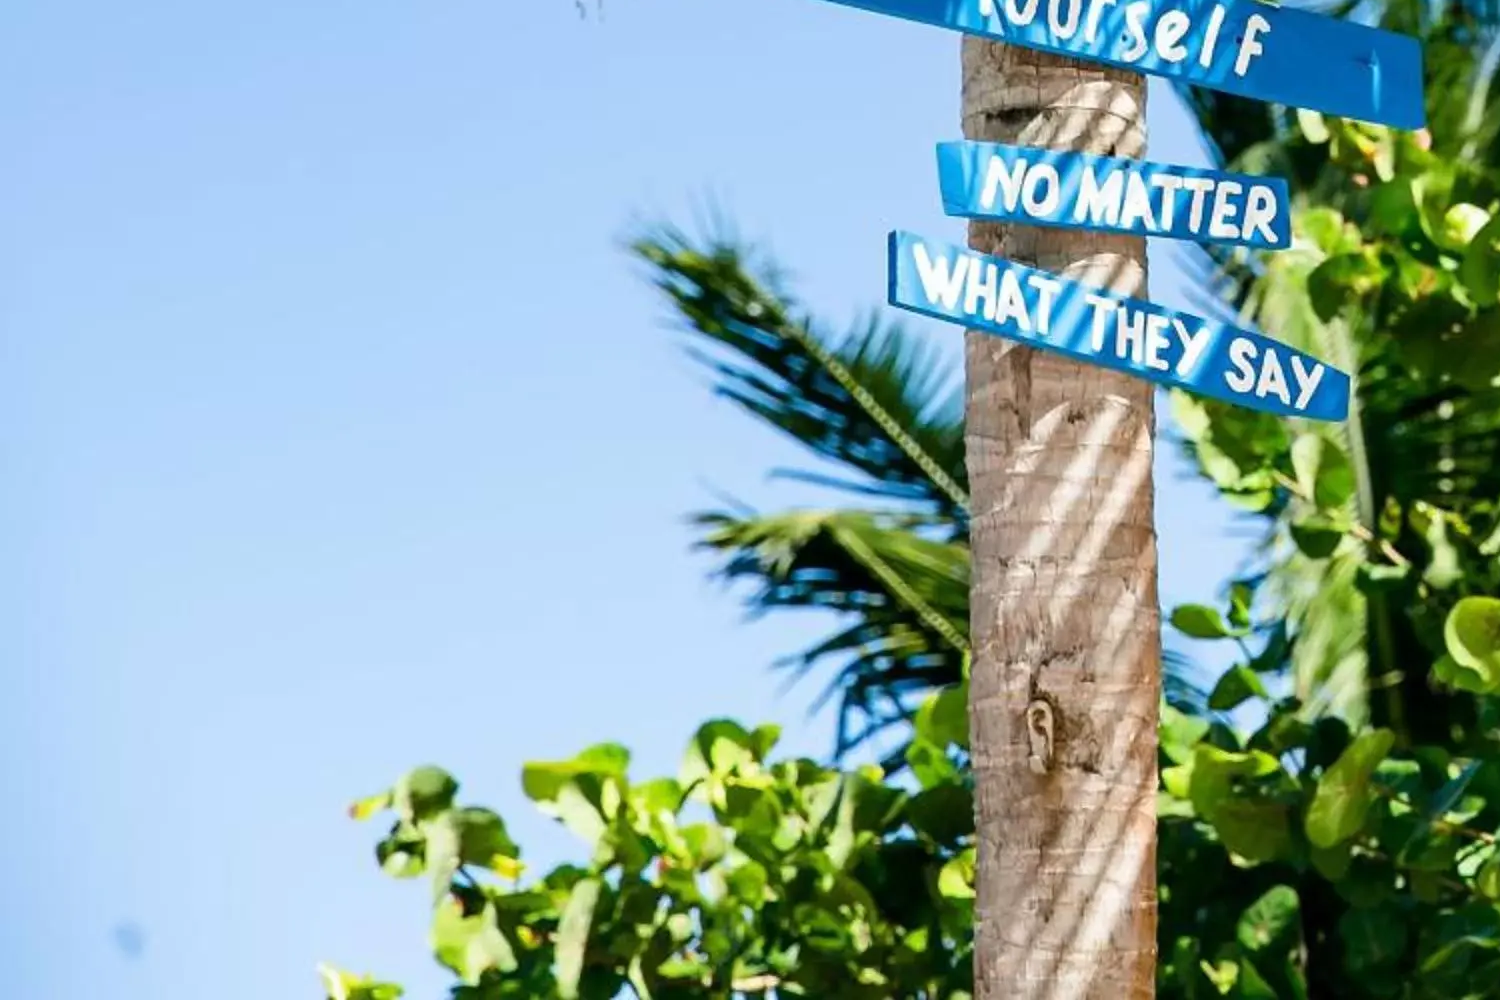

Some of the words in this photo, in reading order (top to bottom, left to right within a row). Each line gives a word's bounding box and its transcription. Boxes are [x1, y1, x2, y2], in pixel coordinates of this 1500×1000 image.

[980, 155, 1060, 218] NO
[1074, 165, 1279, 243] MATTER
[911, 242, 1061, 335] WHAT
[1083, 291, 1211, 377] THEY
[1224, 336, 1325, 411] SAY
